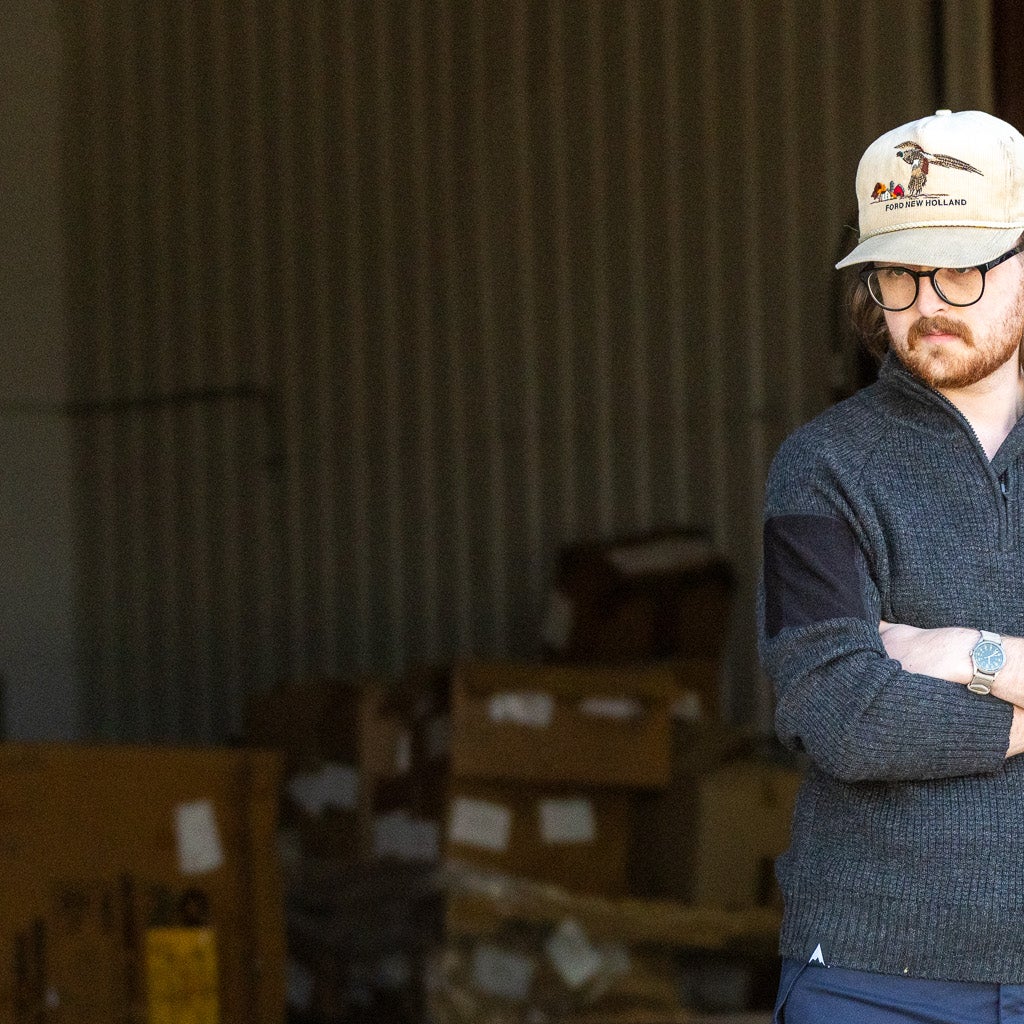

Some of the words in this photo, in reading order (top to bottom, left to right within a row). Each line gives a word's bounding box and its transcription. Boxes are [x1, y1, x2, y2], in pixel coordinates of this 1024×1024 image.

[885, 203, 904, 212] FORD
[905, 200, 923, 208] NEW
[925, 199, 967, 207] HOLLAND
